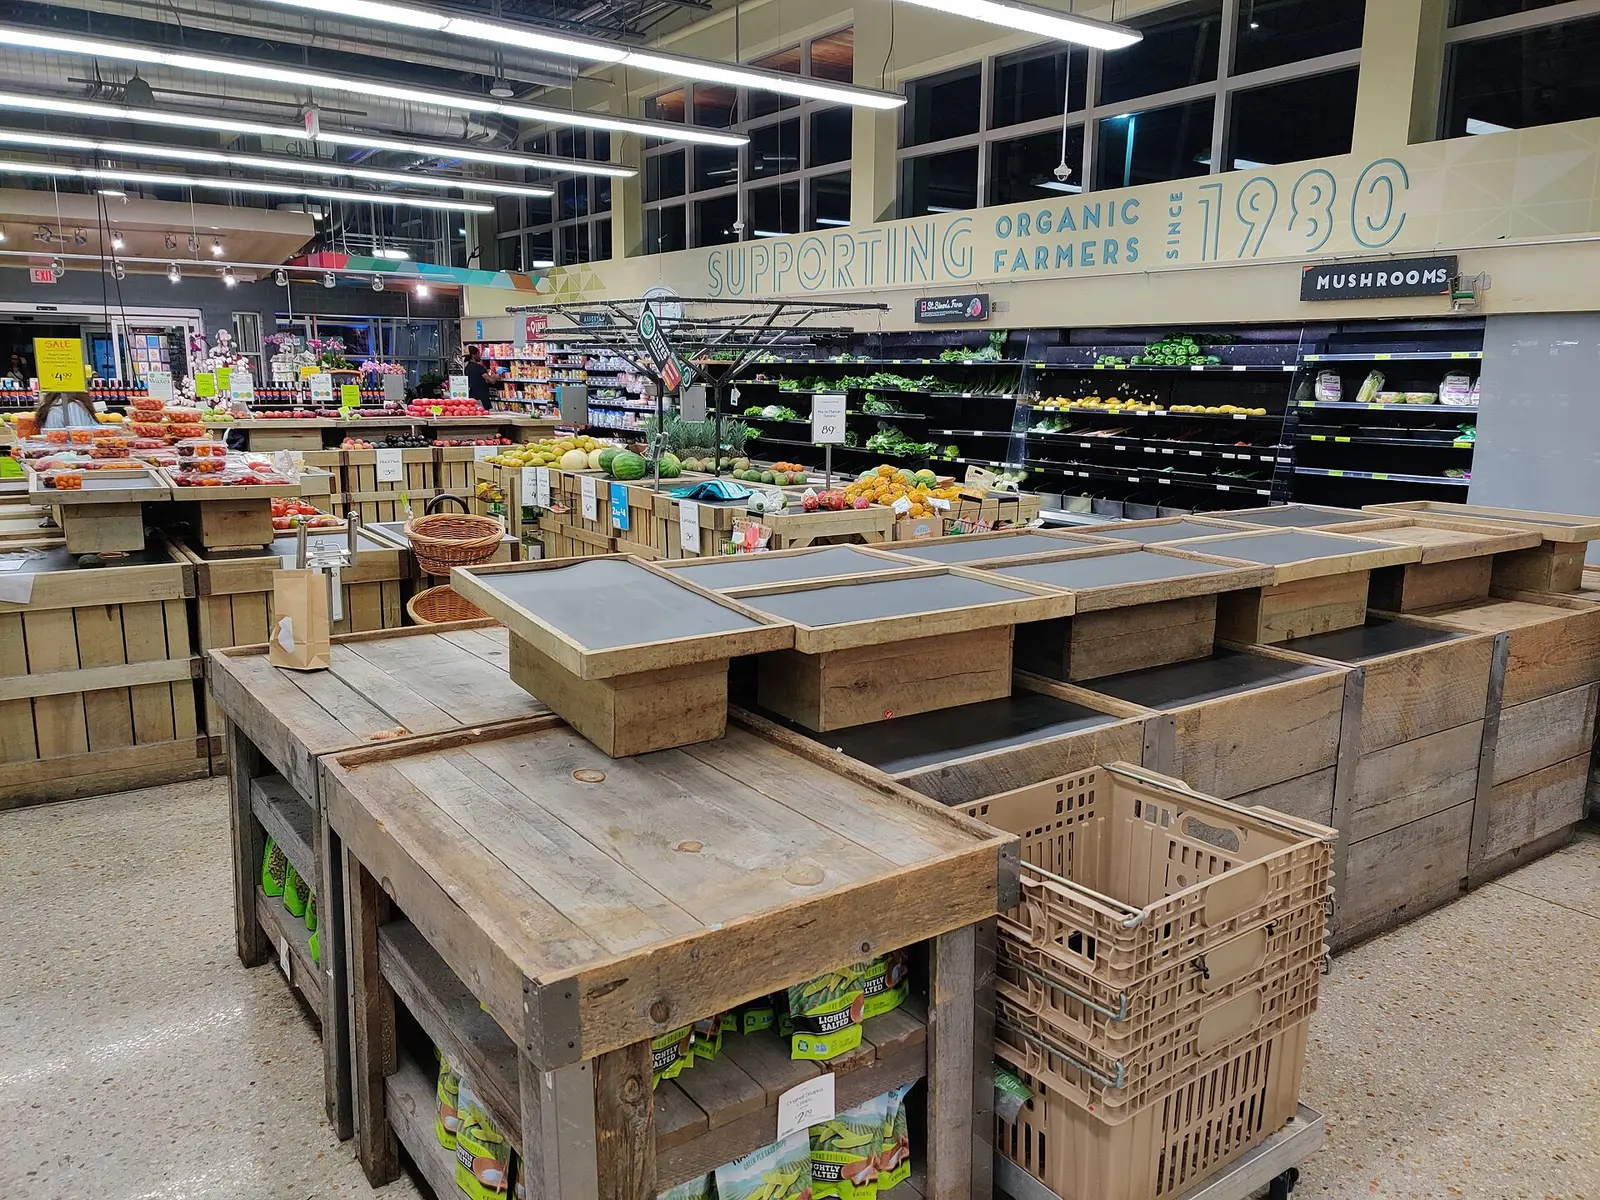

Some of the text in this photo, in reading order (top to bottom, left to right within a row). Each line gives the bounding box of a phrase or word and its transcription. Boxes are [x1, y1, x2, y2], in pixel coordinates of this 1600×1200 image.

[995, 198, 1140, 239] ORGANIC
[1166, 191, 1183, 259] SINCE
[708, 217, 974, 298] SUPPORTING
[993, 236, 1140, 273] FARMERS
[1316, 268, 1447, 291] MUSHROOMS
[44, 340, 72, 348] SALE
[819, 1010, 850, 1025] LIGHTLY
[821, 1018, 849, 1032] SALTED
[653, 1053, 676, 1068] ALTED
[1000, 1073, 1020, 1090] FRUIT
[812, 1171, 838, 1179] ALTED
